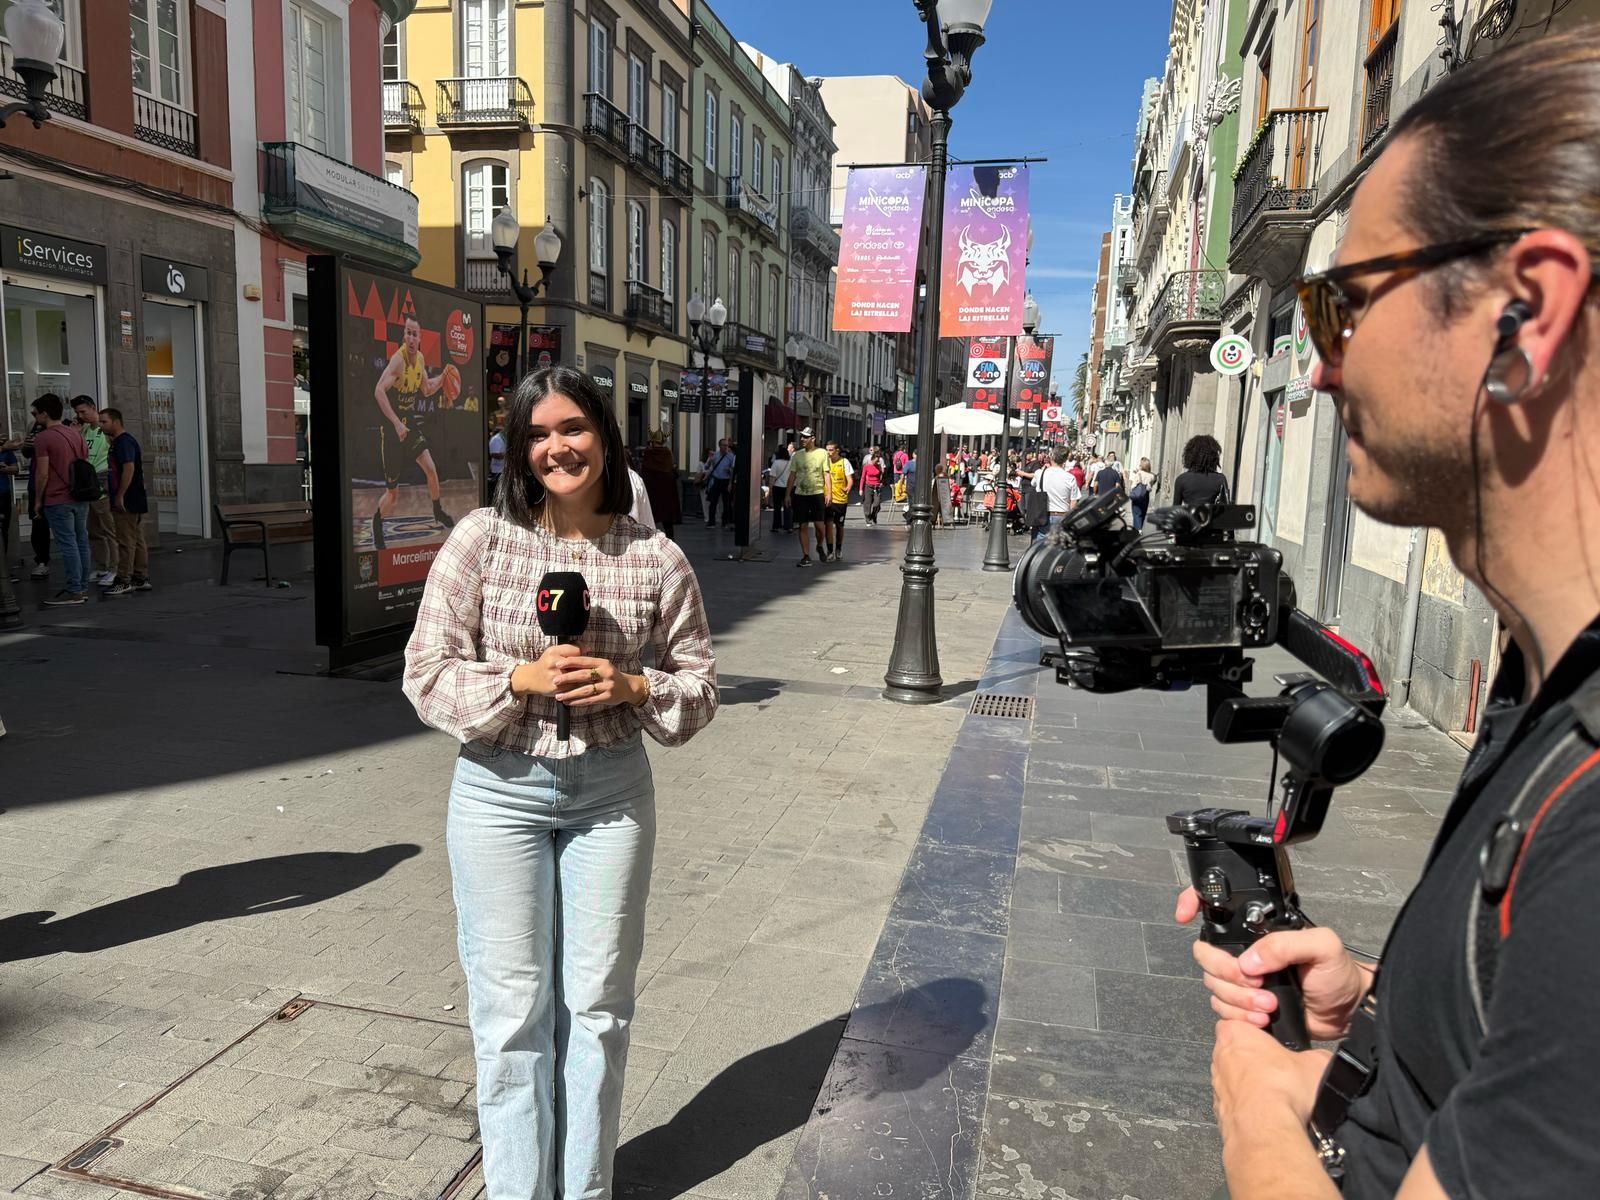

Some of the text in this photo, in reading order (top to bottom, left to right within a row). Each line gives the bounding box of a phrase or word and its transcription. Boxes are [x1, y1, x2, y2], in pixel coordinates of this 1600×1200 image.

[853, 241, 889, 250] endesa
[17, 236, 93, 268] iServices
[851, 301, 876, 309] DONDE
[850, 309, 898, 317] LAS ESTRELLAS
[958, 306, 984, 314] DONDE
[972, 314, 1009, 322] ESTRELLAS
[450, 330, 465, 341] Copa
[980, 362, 995, 372] FAN
[1025, 362, 1040, 371] FAN
[537, 589, 565, 612] C7
